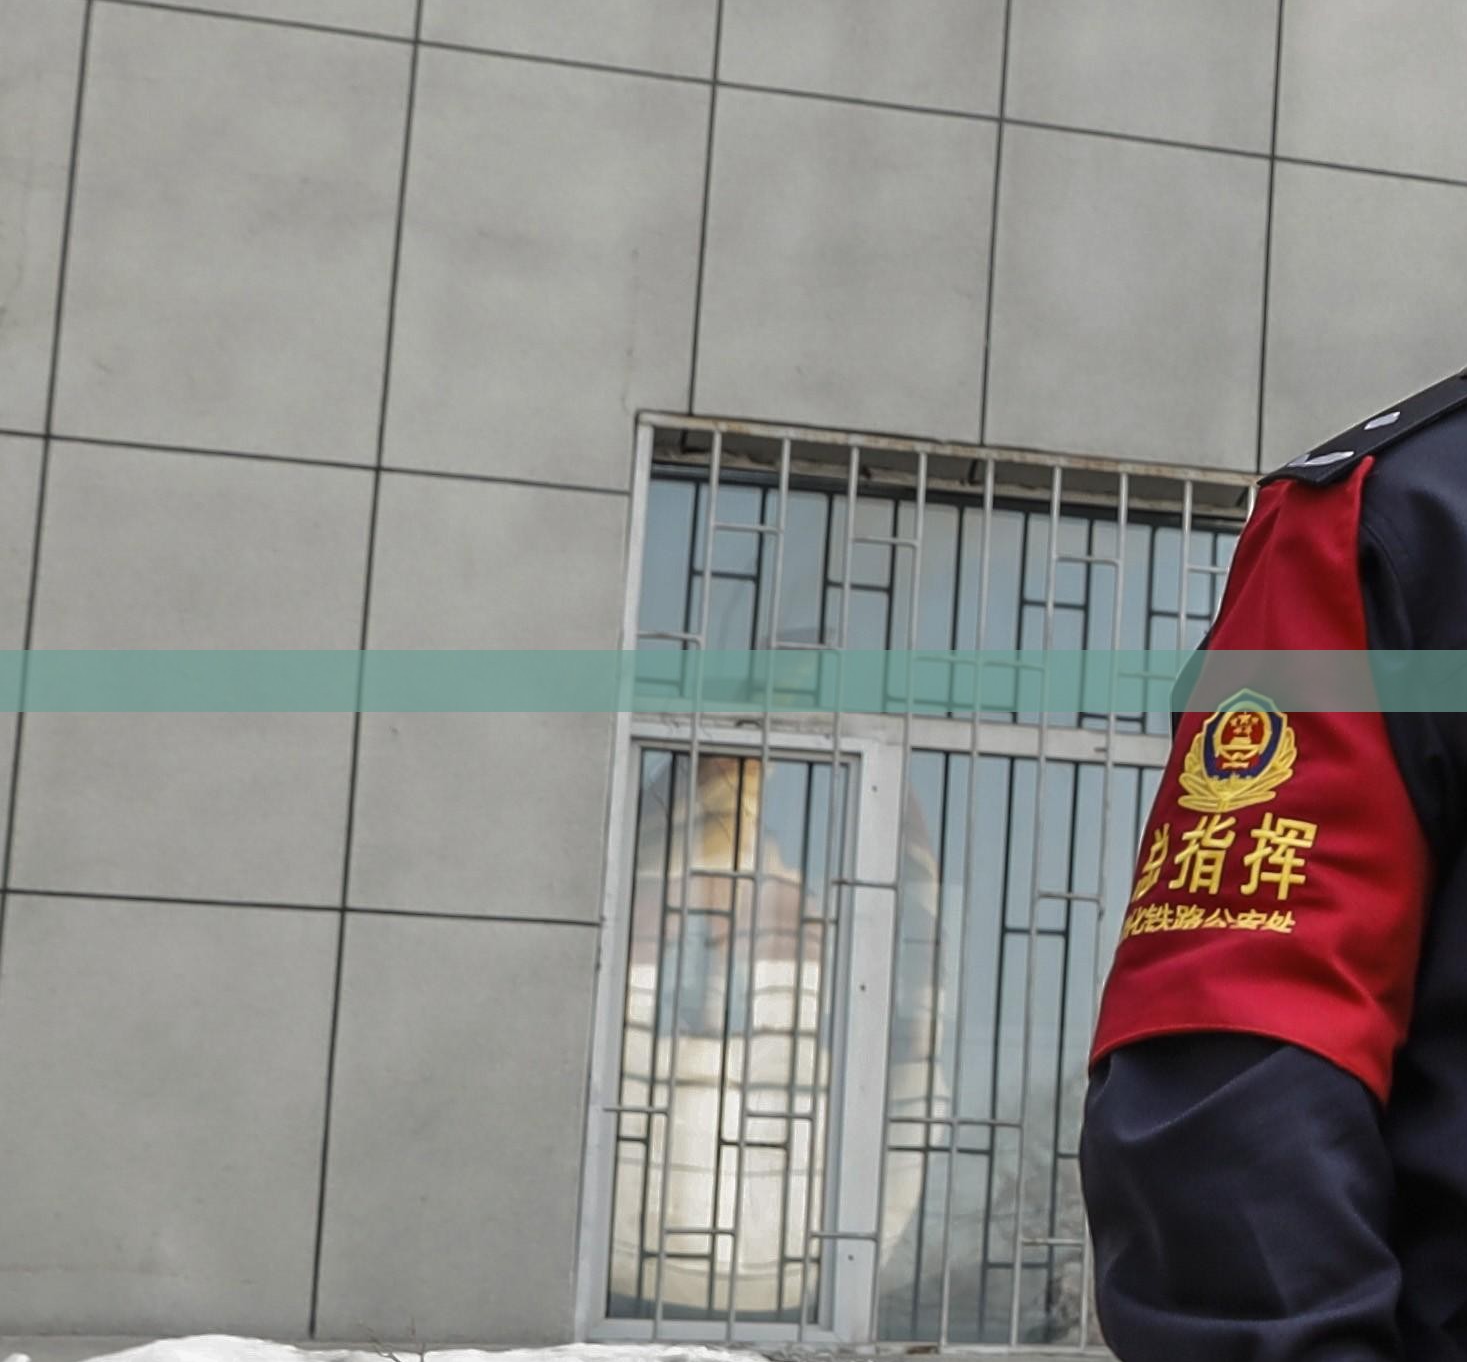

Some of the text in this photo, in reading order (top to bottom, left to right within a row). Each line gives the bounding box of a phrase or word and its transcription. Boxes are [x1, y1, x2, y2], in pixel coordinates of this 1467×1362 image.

[1122, 902, 1296, 938] 化铁路公安处
